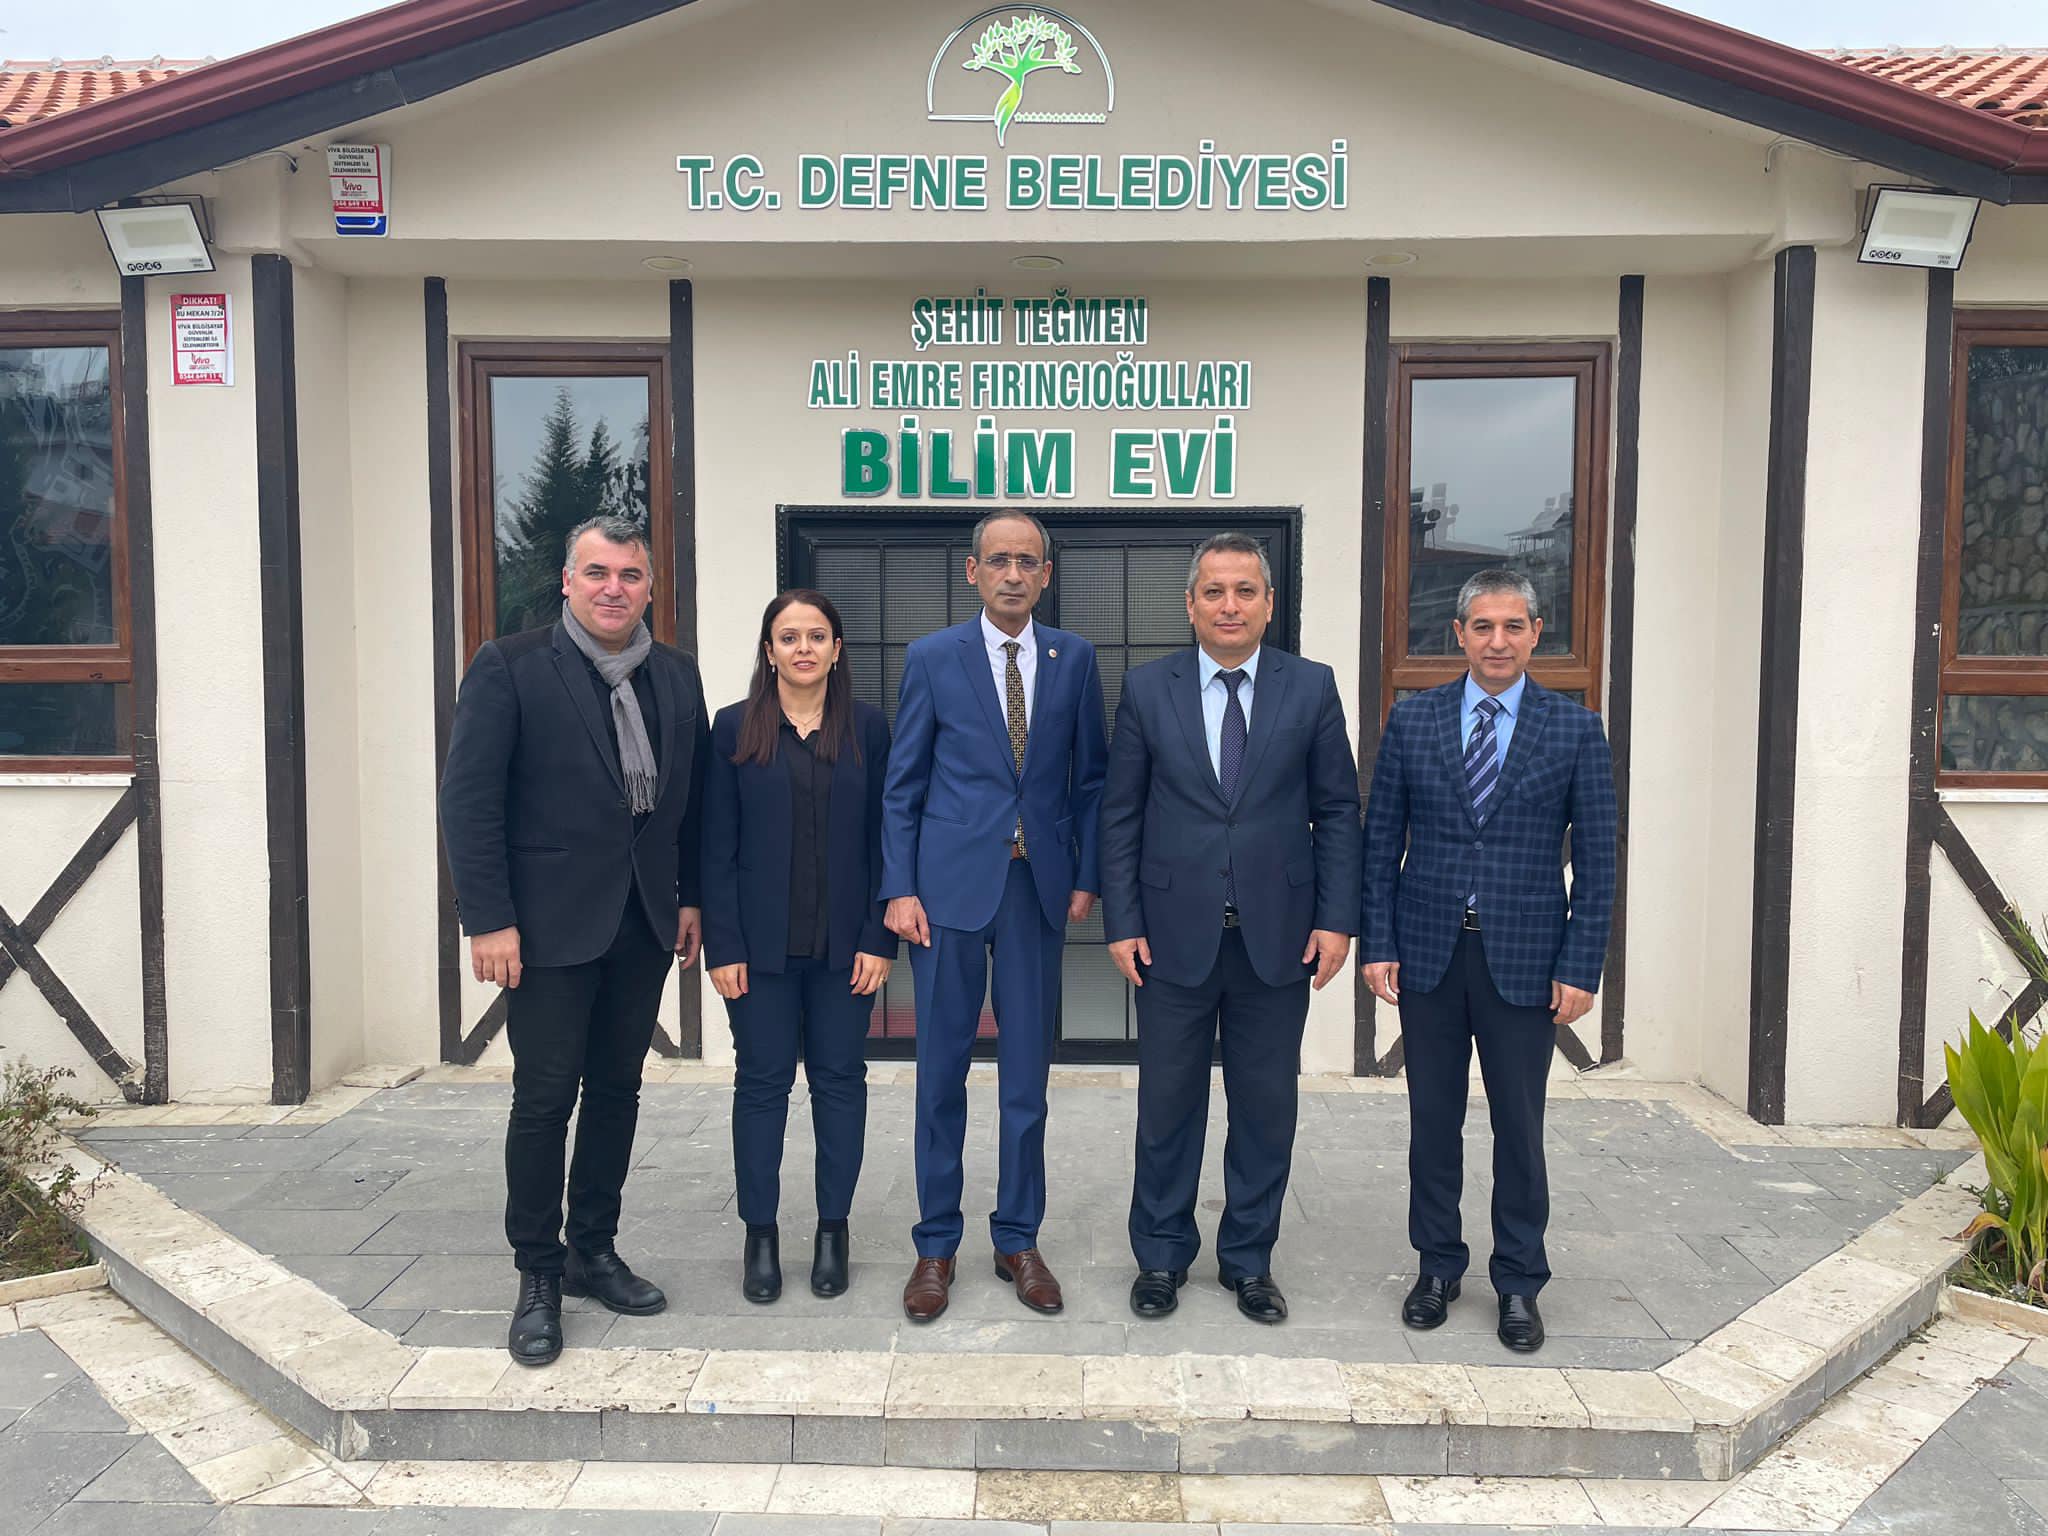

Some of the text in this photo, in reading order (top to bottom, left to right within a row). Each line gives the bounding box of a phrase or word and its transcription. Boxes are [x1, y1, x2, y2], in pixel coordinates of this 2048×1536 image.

[676, 139, 1348, 211] T.C. DEFNE BELEDİYESİ
[912, 288, 1149, 351] ŞEHİT TEĞMEN
[808, 351, 1252, 410] ALİ EMRE FIRINCIOĞULLARI
[841, 415, 1236, 499] BİLİM EVİ
